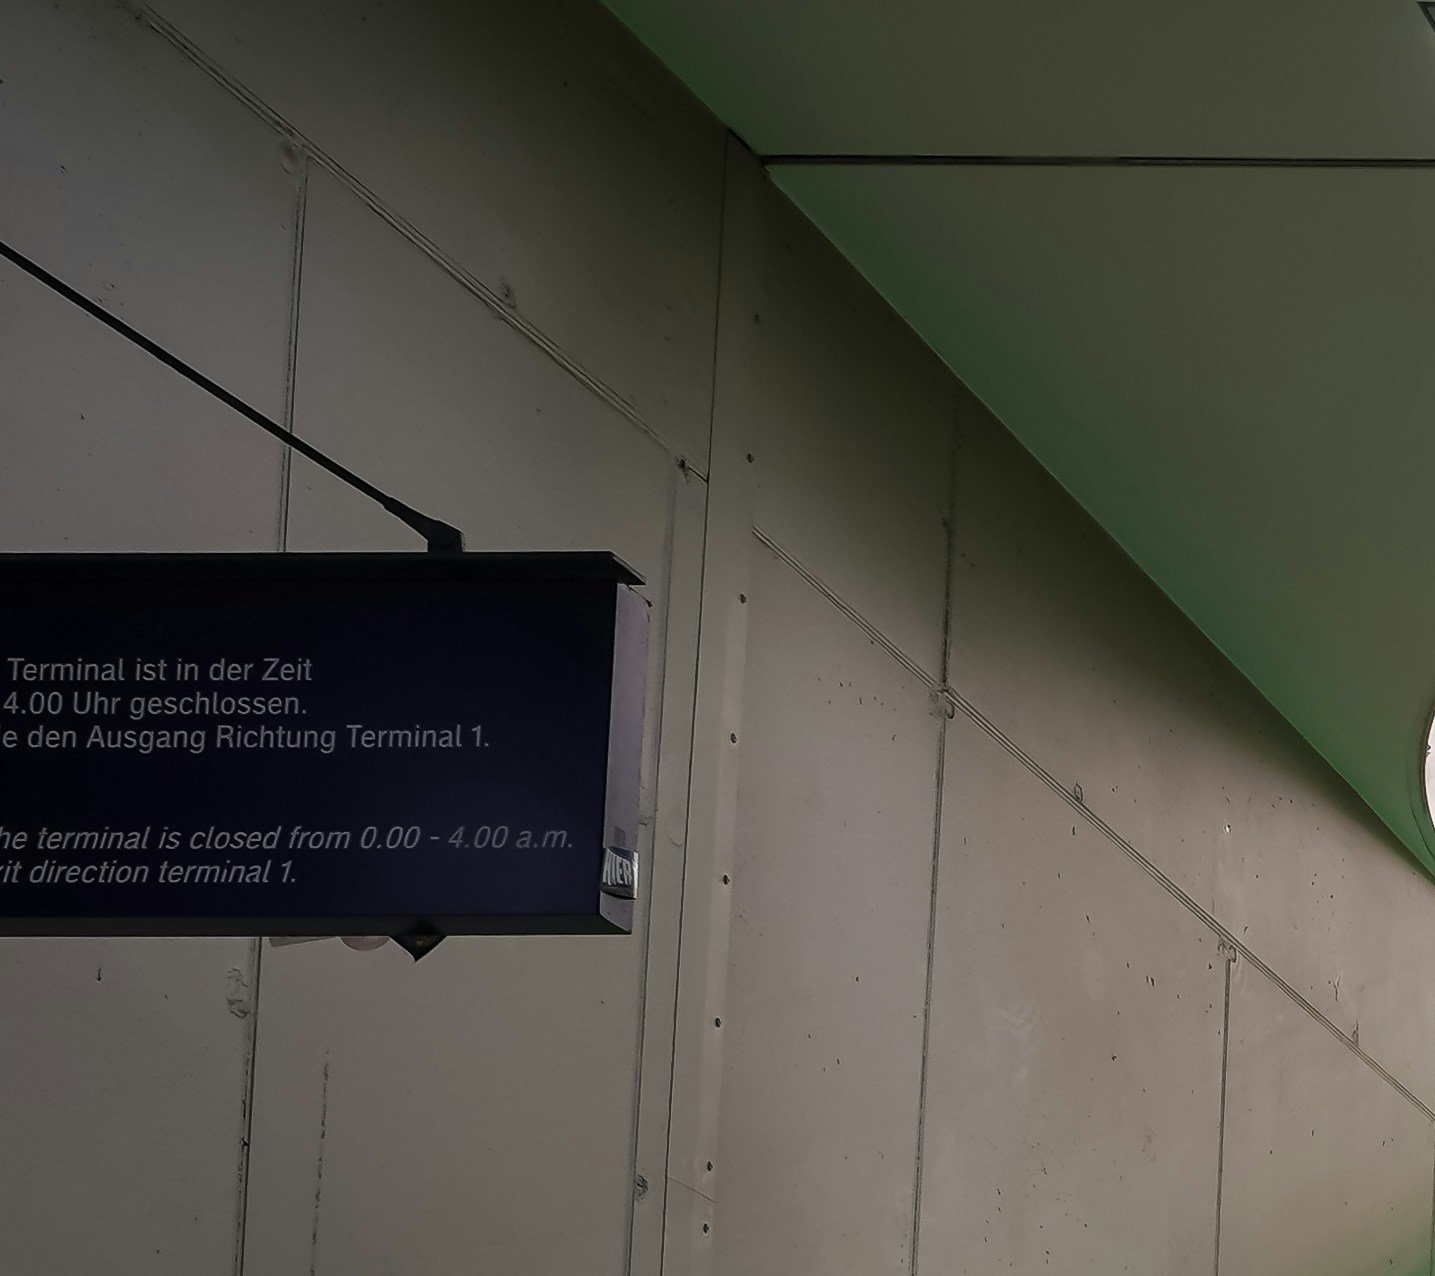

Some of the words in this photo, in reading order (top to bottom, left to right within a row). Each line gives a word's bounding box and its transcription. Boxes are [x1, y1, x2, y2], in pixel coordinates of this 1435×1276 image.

[7, 657, 125, 682] Terminal
[135, 658, 168, 681] ist
[176, 658, 199, 681] in
[209, 658, 254, 681] der
[261, 657, 313, 681] Zeit
[3, 691, 63, 715] 4.00
[73, 691, 121, 715] Uhr
[129, 691, 307, 721] geschlossen.
[27, 725, 77, 749] den
[85, 725, 206, 754] Ausgang
[216, 724, 336, 754] Richtung
[346, 724, 462, 748] Terminal
[471, 724, 490, 748] 1.
[38, 826, 151, 850] terminal
[158, 826, 182, 850] is
[189, 825, 282, 850] closed
[289, 826, 351, 849] from
[360, 825, 421, 849] 0.00
[448, 826, 509, 849] 4.00
[516, 830, 573, 849] a.m.
[0, 860, 23, 883] it
[29, 859, 149, 884] direction
[158, 859, 272, 883] terminal
[281, 860, 296, 883] 1.
